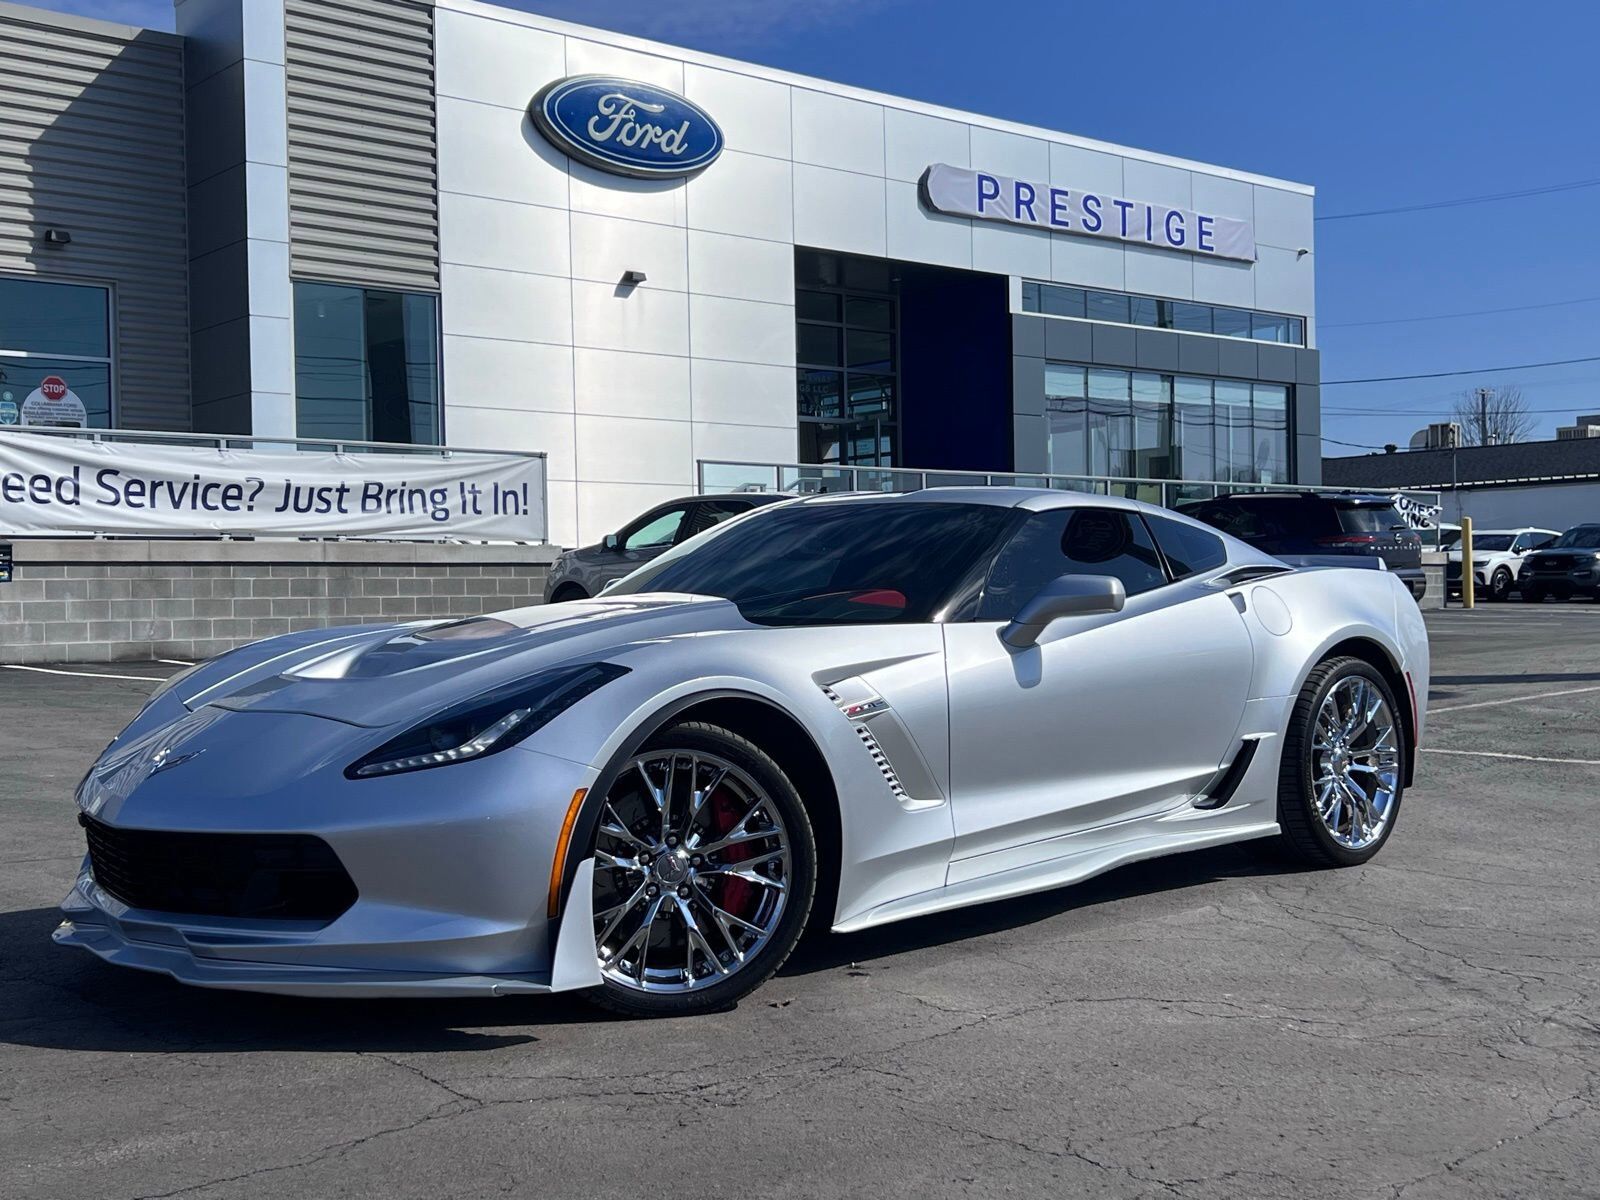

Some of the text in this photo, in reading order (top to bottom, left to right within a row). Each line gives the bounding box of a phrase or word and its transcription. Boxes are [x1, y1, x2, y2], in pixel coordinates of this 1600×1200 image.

[588, 93, 690, 155] Ford
[976, 173, 1215, 252] PRESTIGE
[43, 383, 65, 394] STOP
[1, 465, 529, 522] eed Service? Just Bring It In!
